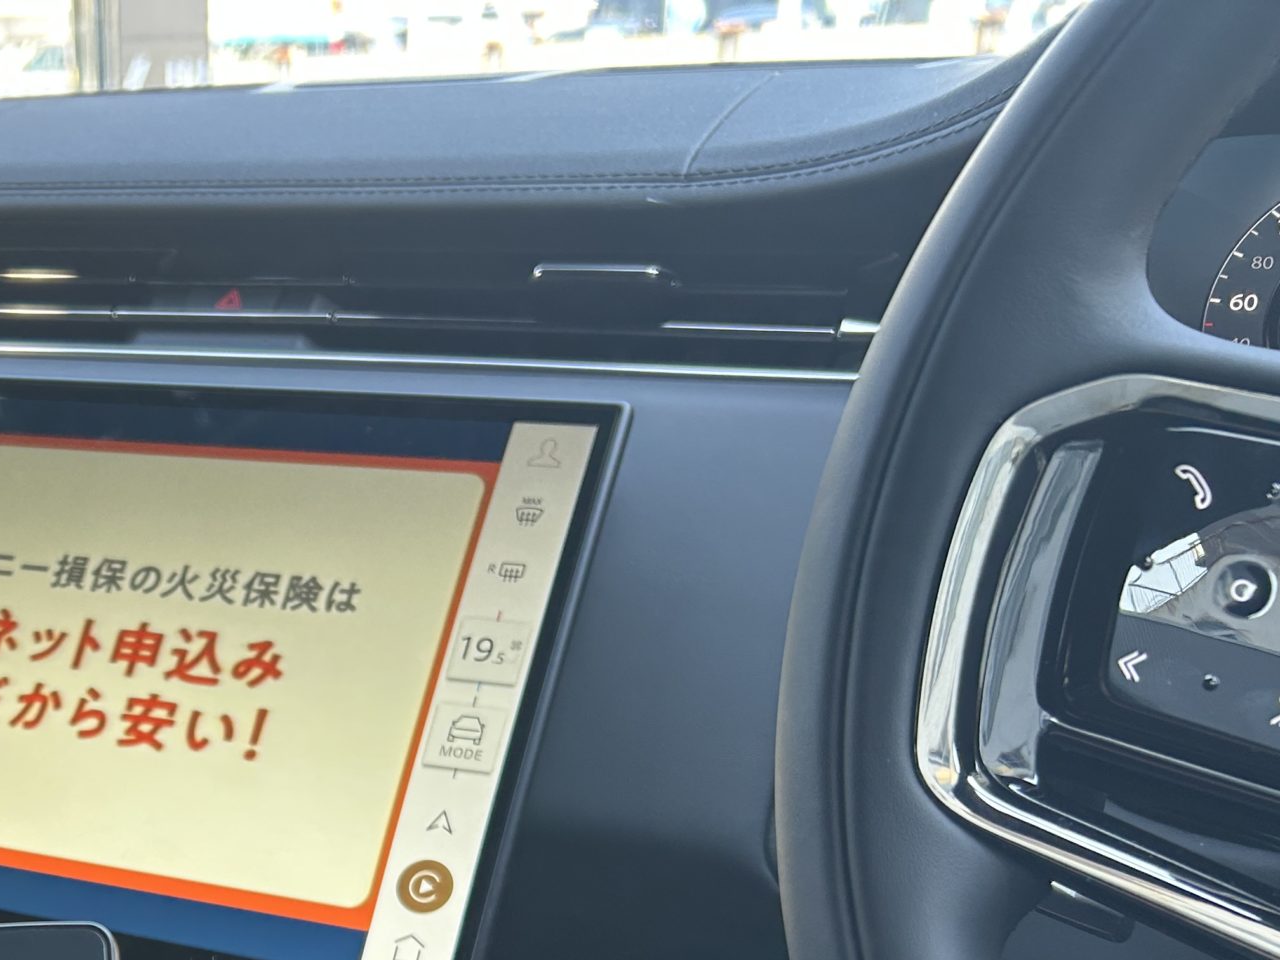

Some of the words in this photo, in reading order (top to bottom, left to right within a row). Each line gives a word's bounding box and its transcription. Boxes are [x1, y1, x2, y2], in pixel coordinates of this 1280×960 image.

[1251, 256, 1274, 270] 80
[1229, 293, 1259, 312] 60
[438, 744, 483, 762] MODE
